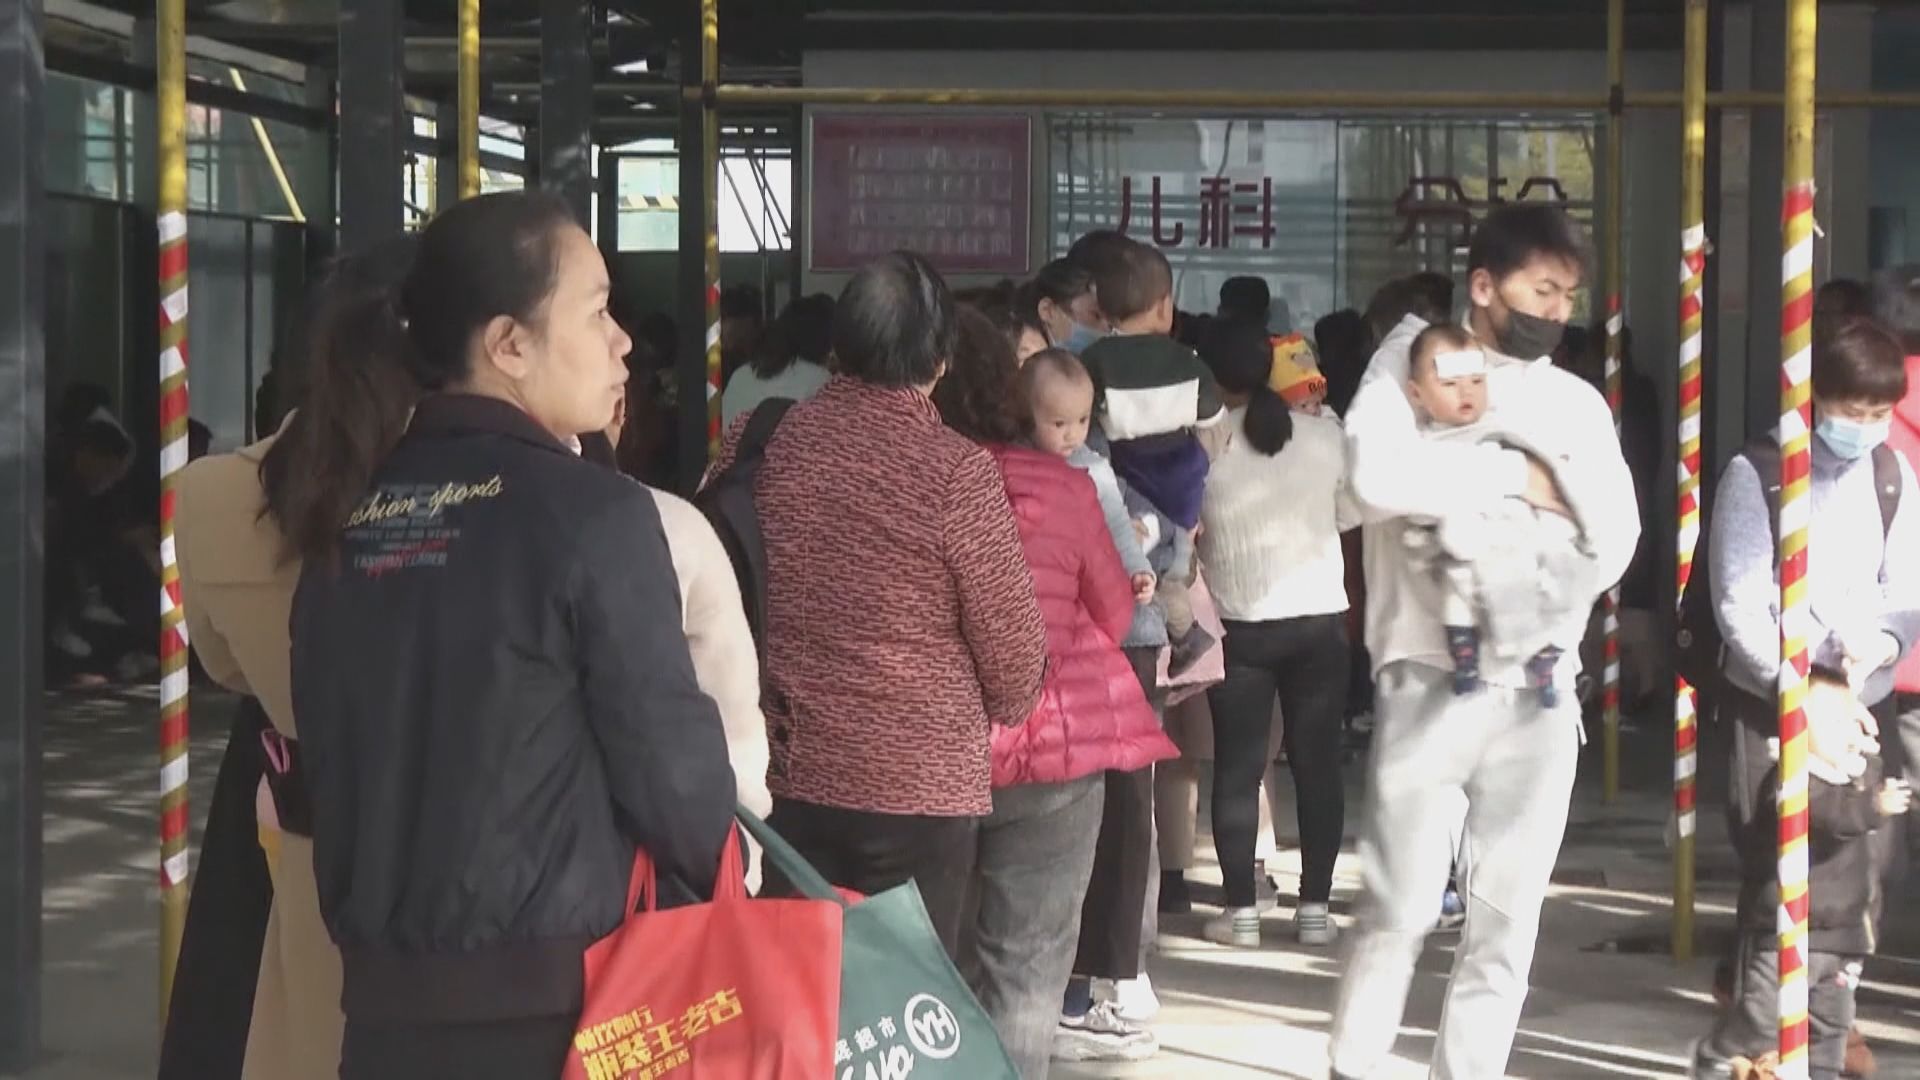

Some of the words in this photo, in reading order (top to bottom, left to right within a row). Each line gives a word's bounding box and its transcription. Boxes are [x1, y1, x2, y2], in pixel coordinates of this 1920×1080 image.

[1119, 176, 1277, 249] 儿科
[428, 474, 503, 519] sports
[912, 1003, 957, 1047] YH
